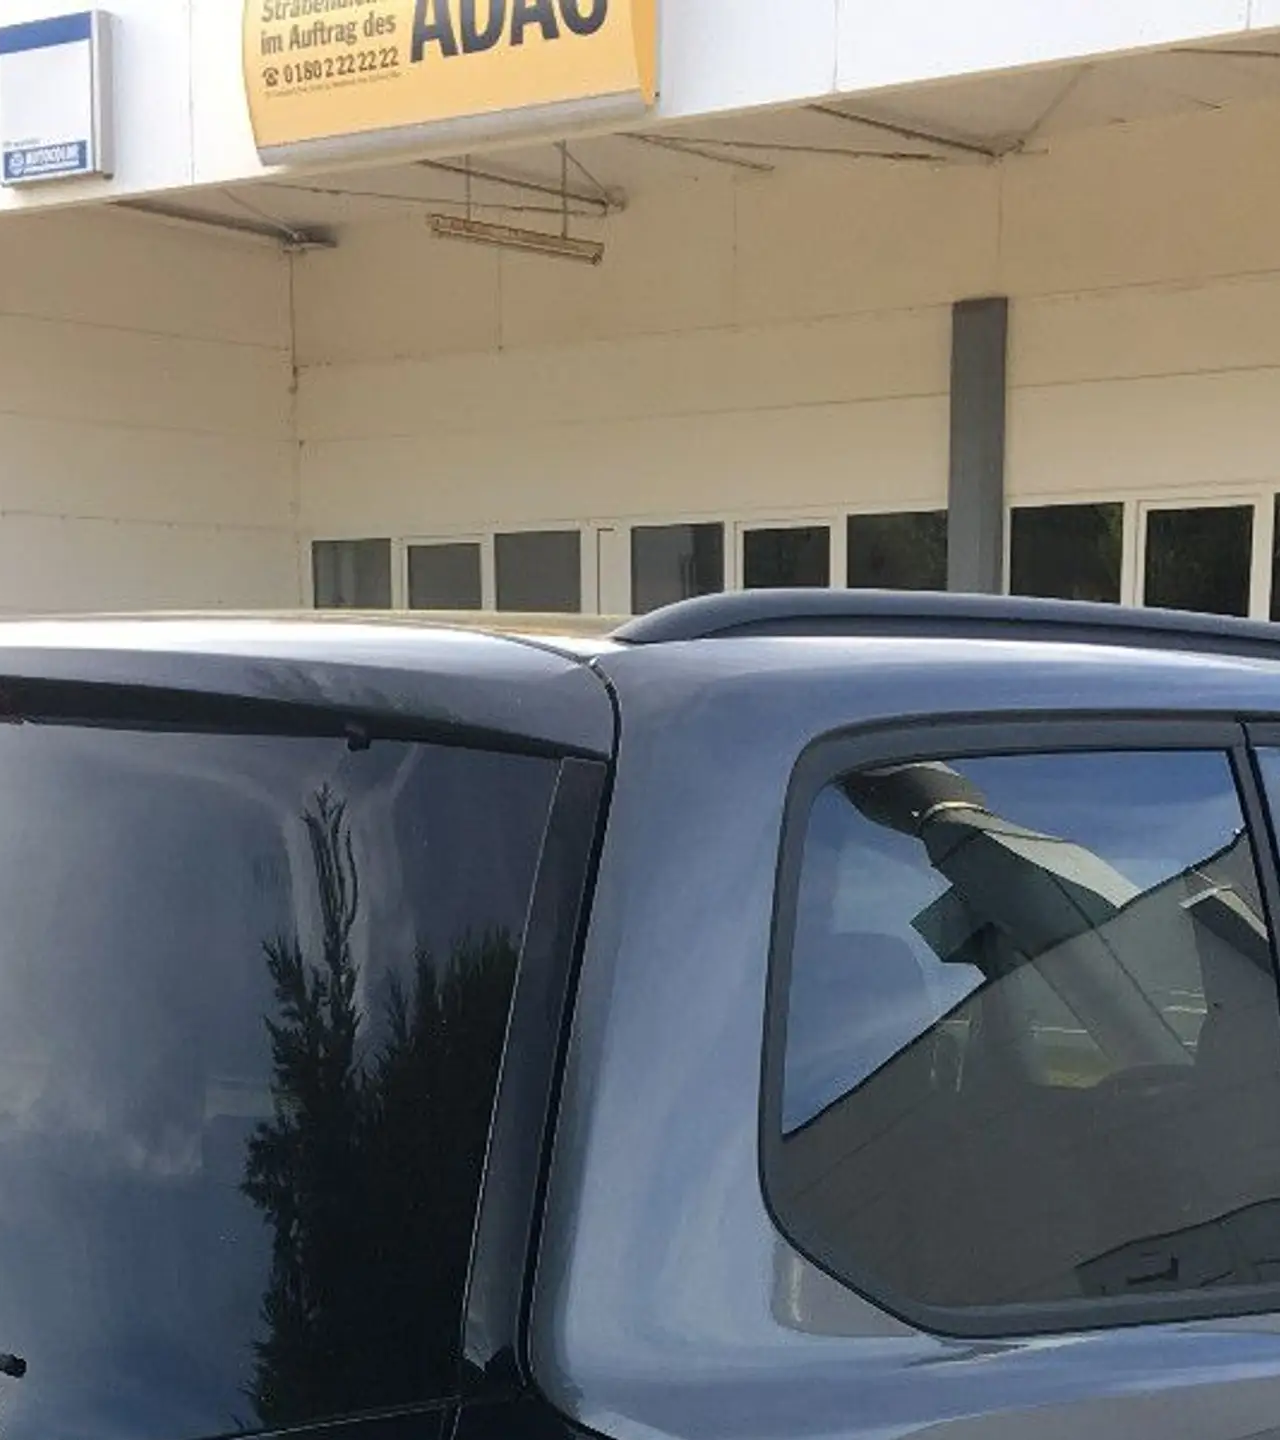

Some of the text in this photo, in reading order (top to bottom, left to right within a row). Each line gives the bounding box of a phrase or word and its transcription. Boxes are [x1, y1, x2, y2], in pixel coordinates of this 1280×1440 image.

[261, 10, 397, 55] im Auftrag des
